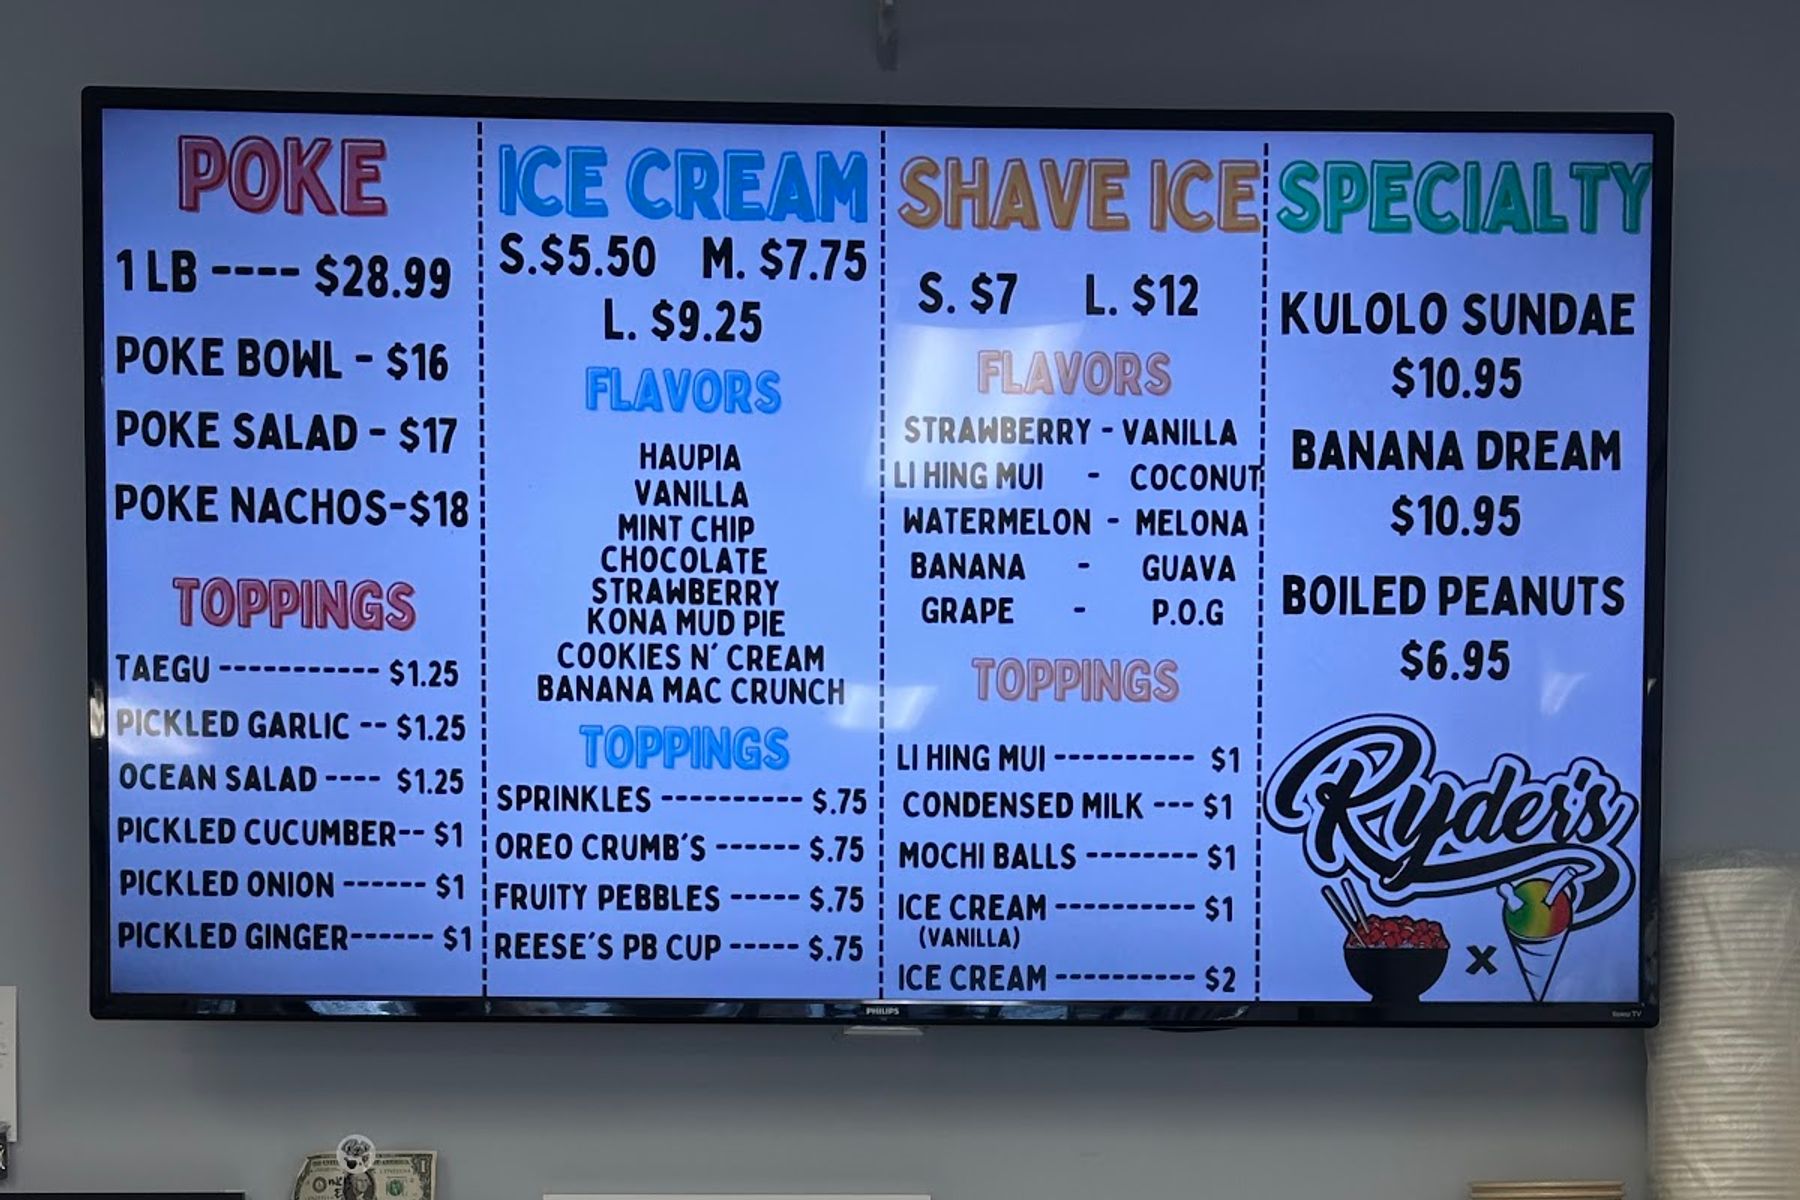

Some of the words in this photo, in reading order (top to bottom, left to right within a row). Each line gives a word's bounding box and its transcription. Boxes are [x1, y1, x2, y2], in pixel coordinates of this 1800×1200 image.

[177, 135, 388, 217] POKE
[499, 144, 608, 219] ICE
[625, 147, 868, 223] CREAM
[897, 156, 1131, 233] SHAVE
[1150, 158, 1262, 233] ICE
[1276, 159, 1653, 235] SPECIALTY
[116, 249, 134, 291] 1
[147, 250, 197, 293] LB
[315, 254, 452, 299] $28.99
[703, 236, 745, 280] M.
[760, 238, 867, 282] $7.75
[918, 271, 956, 314] S.
[970, 272, 1018, 315] $7
[1086, 274, 1117, 316] L.
[1132, 273, 1199, 317] $12
[604, 298, 636, 341] L.
[652, 299, 762, 343] $9.25
[1280, 291, 1447, 335] KULOLO
[1461, 292, 1635, 336] SUNDAE
[116, 336, 224, 376] POKE
[237, 339, 342, 379] BOWL
[387, 342, 449, 381] $16
[977, 349, 1172, 397] FLAVORS
[585, 366, 782, 414] FLAVORS
[1391, 356, 1522, 399] $10.95
[116, 410, 220, 448] POKE
[233, 413, 357, 451] SALAD
[399, 416, 458, 454] $17
[904, 415, 1091, 446] STRAWBERRY
[1122, 418, 1237, 446] VANILLA
[640, 442, 741, 471] HAUPIA
[1292, 430, 1463, 471] BANANA
[1477, 431, 1620, 471] DREAM
[893, 461, 915, 489] LI
[924, 462, 988, 490] HING
[996, 463, 1043, 490] MUI
[1130, 463, 1262, 492] COCONUT
[115, 484, 218, 522] POKE
[634, 479, 749, 508] VANILLA
[618, 514, 683, 541] MINT
[691, 515, 755, 542] CHIP
[903, 507, 1091, 536] WATERMELON
[1135, 508, 1249, 537] MELONA
[1390, 495, 1521, 537] $10.95
[601, 546, 768, 575] CHOCOLATE
[910, 552, 1026, 581] BANANA
[1142, 555, 1236, 583] GUAVA
[172, 576, 417, 631] TOPPINGS
[592, 577, 780, 606] STRAWBERRY
[1282, 574, 1426, 616] BOILED
[1438, 576, 1625, 617] PEANUTS
[587, 608, 667, 636] KONA
[676, 609, 735, 637] MUD
[743, 609, 785, 637] PIE
[921, 597, 1014, 625] GRAPE
[1152, 599, 1223, 626] P.O.G
[115, 654, 210, 683] TAEGU
[390, 659, 459, 687] $1.25
[557, 642, 681, 670] COOKIES
[726, 644, 824, 672] CREAM
[1400, 640, 1510, 681] $6.95
[537, 674, 654, 703] BANANA
[663, 676, 722, 703] MAC
[730, 678, 845, 705] CRUNCH
[971, 657, 1180, 703] TOPPINGS
[117, 709, 240, 737] PICKLED
[248, 711, 350, 740] GARLIC
[397, 713, 466, 742] $1.25
[579, 724, 791, 770] TOPPINGS
[897, 744, 918, 771] LI
[927, 744, 990, 771] HING
[999, 744, 1045, 772] MUI
[1211, 746, 1240, 773] $1
[119, 763, 216, 790] OCEAN
[225, 766, 318, 792] SALAD
[397, 768, 464, 795] $1.25
[496, 784, 651, 813] SPRINKLES
[812, 787, 867, 816] $.75
[903, 791, 1073, 819] CONDENSED
[1082, 792, 1143, 819] MILK
[1203, 793, 1232, 820] $1
[117, 817, 236, 844] PICKLED
[435, 821, 463, 847] $1
[1263, 712, 1640, 931] Ryder's
[495, 832, 573, 861] OREO
[582, 833, 706, 862] CRUMB'S
[809, 835, 864, 863] $.75
[899, 841, 985, 869] MOCHI
[993, 842, 1076, 870] BALLS
[1207, 844, 1236, 871] $1
[120, 869, 238, 897] PICKLED
[247, 871, 334, 898] ONION
[436, 874, 465, 899] $1
[494, 882, 587, 911] FRUITY
[598, 884, 720, 912] PEBBLES
[809, 885, 864, 913] $.75
[898, 893, 941, 920] ICE
[950, 894, 1046, 921] CREAM
[1205, 895, 1233, 922] $1
[118, 922, 236, 949] PICKLED
[444, 926, 472, 952] $1
[494, 932, 614, 961] REESE'S
[623, 934, 658, 961] PB
[666, 934, 722, 961] CUP
[808, 934, 864, 962] $.75
[919, 925, 1020, 949] (VANILLA)
[898, 964, 941, 991] ICE
[950, 964, 1046, 991] CREAM
[1205, 966, 1236, 993] $2
[866, 1007, 899, 1015] PHILIPS
